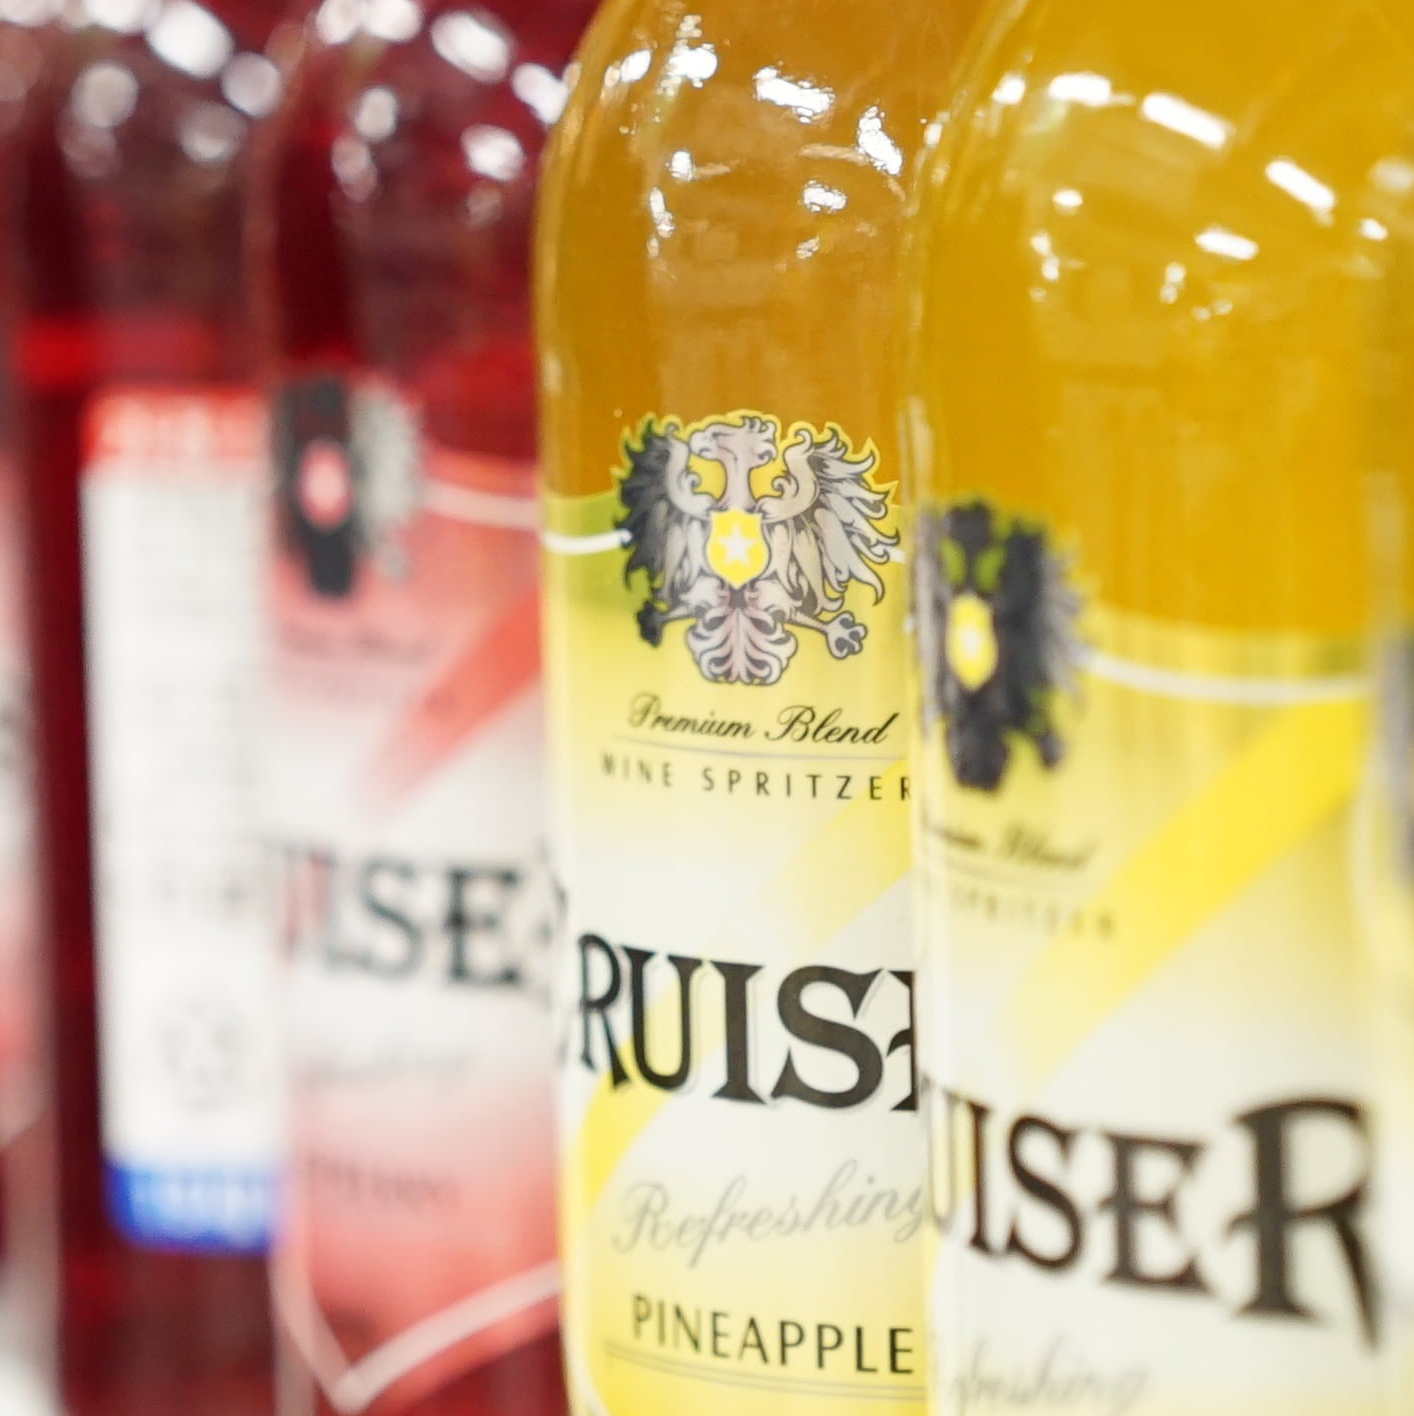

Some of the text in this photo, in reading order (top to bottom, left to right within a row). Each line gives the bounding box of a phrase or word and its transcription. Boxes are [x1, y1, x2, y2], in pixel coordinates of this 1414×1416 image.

[628, 691, 901, 745] Premium Blend
[701, 766, 911, 802] SPRITZER
[569, 916, 918, 1112] RUIS
[611, 1157, 927, 1270] Refreshing
[923, 1080, 1383, 1356] UISER
[632, 1292, 915, 1375] PINEAPPLE
